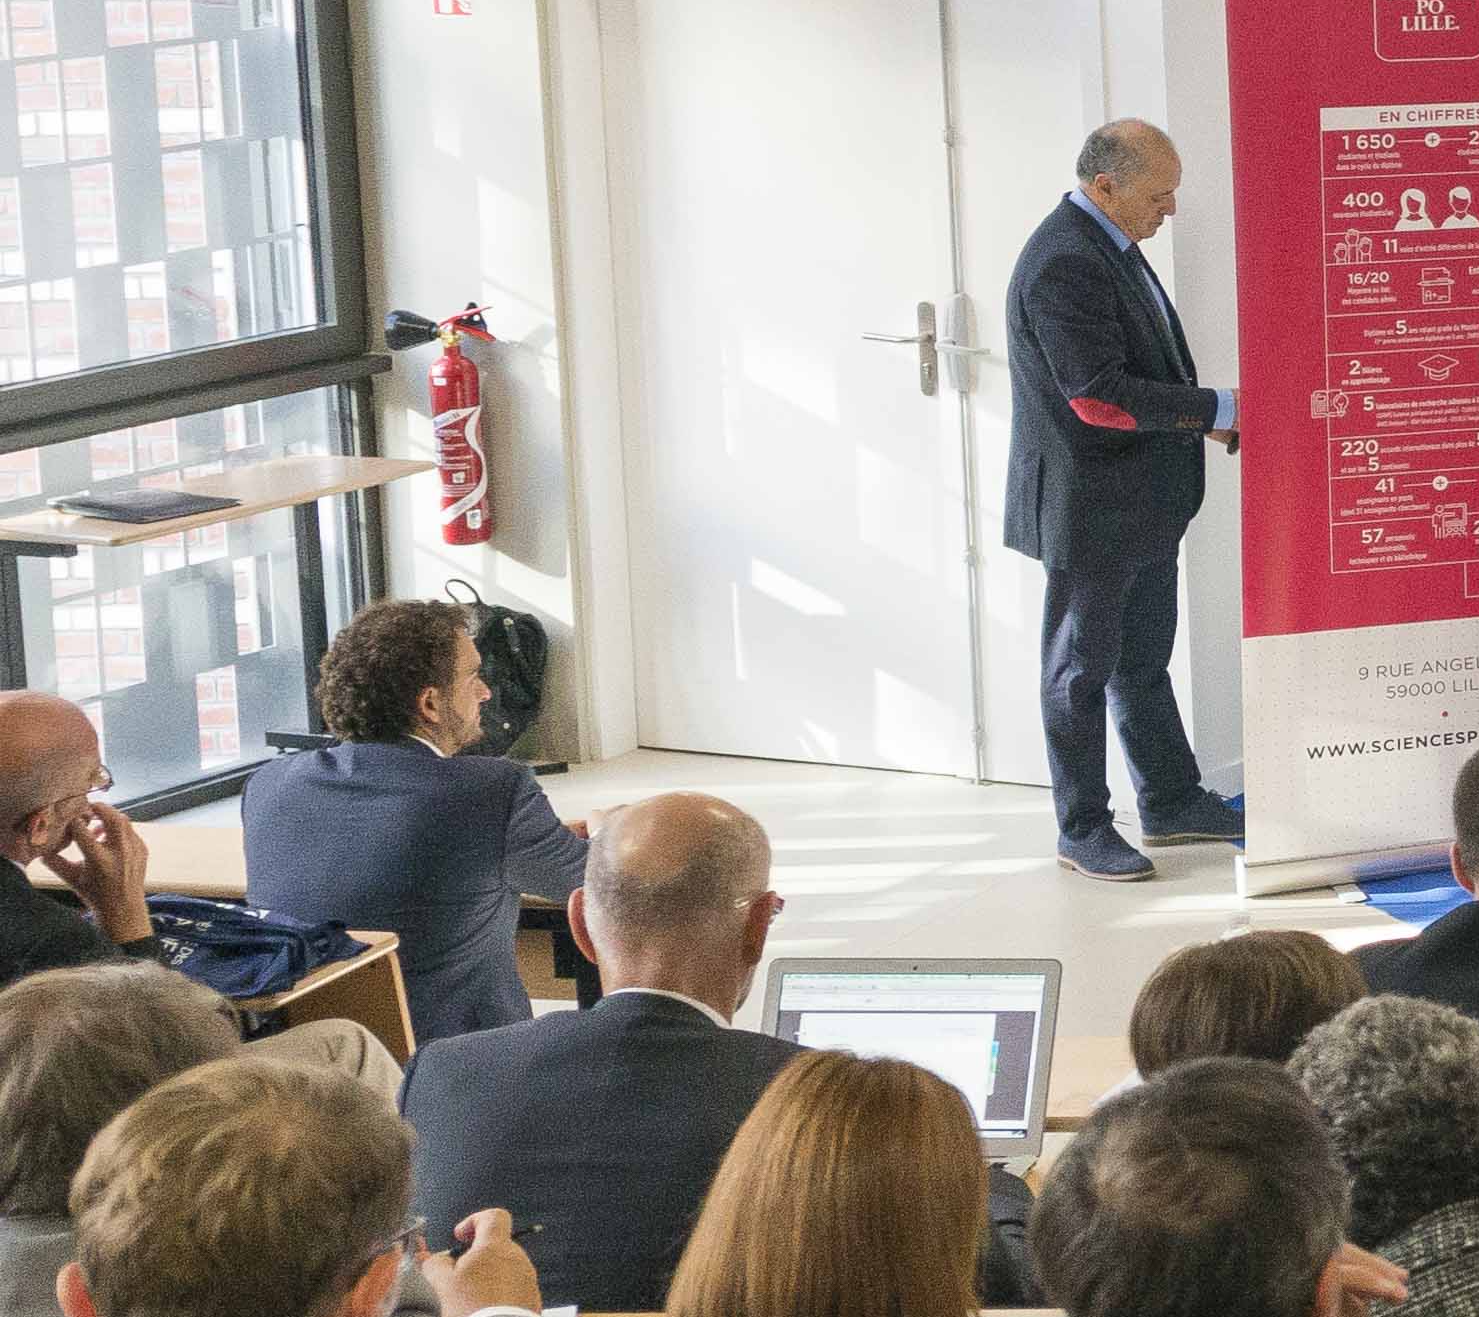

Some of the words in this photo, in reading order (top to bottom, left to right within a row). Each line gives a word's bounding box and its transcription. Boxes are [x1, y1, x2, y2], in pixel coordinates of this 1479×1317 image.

[1400, 15, 1460, 32] LILLE.
[1379, 111, 1399, 123] EN
[1356, 133, 1396, 150] 650
[1342, 192, 1384, 208] 400
[1382, 238, 1398, 254] 11
[1347, 271, 1390, 286] 16/20
[1395, 320, 1408, 335] 5
[1349, 360, 1361, 375] 2
[1363, 396, 1374, 412] 5
[1341, 440, 1378, 457] 220
[1368, 457, 1379, 472] 5
[1374, 478, 1395, 493] 41
[1361, 528, 1384, 544] 57
[1358, 666, 1369, 681] 9
[1376, 661, 1413, 679] RUE
[1385, 680, 1446, 700] 59000
